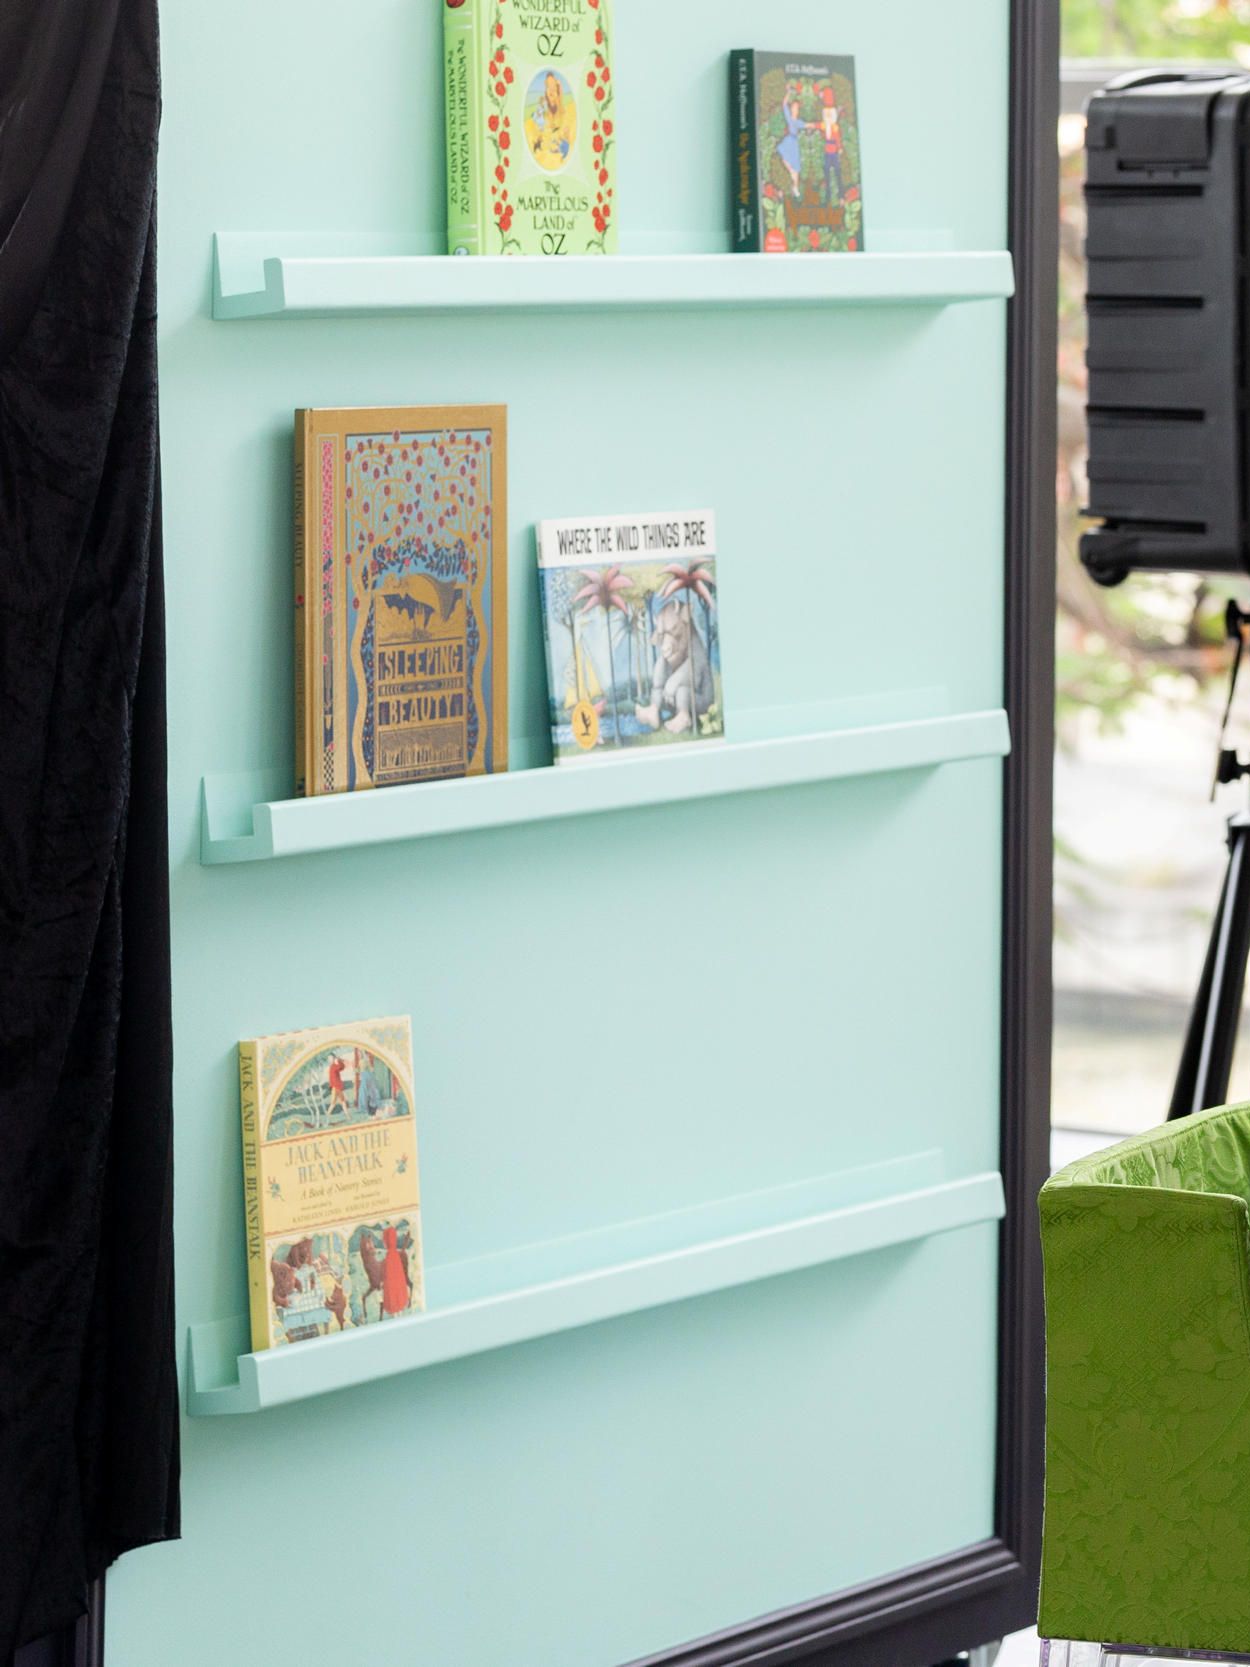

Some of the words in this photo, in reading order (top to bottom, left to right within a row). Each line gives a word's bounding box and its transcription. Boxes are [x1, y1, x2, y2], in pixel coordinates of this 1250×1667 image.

[519, 15, 570, 32] WIZARD
[572, 18, 584, 32] of
[537, 34, 564, 57] OZ
[458, 55, 468, 130] WONDERFUL
[460, 132, 469, 184] WIZARD
[450, 187, 458, 205] OZ
[545, 181, 560, 195] The
[461, 197, 470, 215] OZ
[516, 196, 589, 213] MARVELOUS
[533, 215, 565, 230] LAND
[567, 216, 578, 230] of
[541, 233, 568, 255] OZ
[557, 528, 592, 555] WHERE
[595, 526, 612, 552] THE
[616, 525, 639, 550] WILD
[642, 522, 679, 549] THINGS
[684, 520, 706, 546] ARE
[389, 693, 453, 725] BEAUTY
[240, 1054, 253, 1091] JACK
[242, 1099, 255, 1132] AND
[245, 1142, 257, 1169] THE
[285, 1141, 323, 1167] JACK
[328, 1135, 359, 1157] AND
[361, 1129, 391, 1151] THE
[298, 1151, 383, 1184] BEANSTALK
[246, 1176, 260, 1260] BEANSTALK
